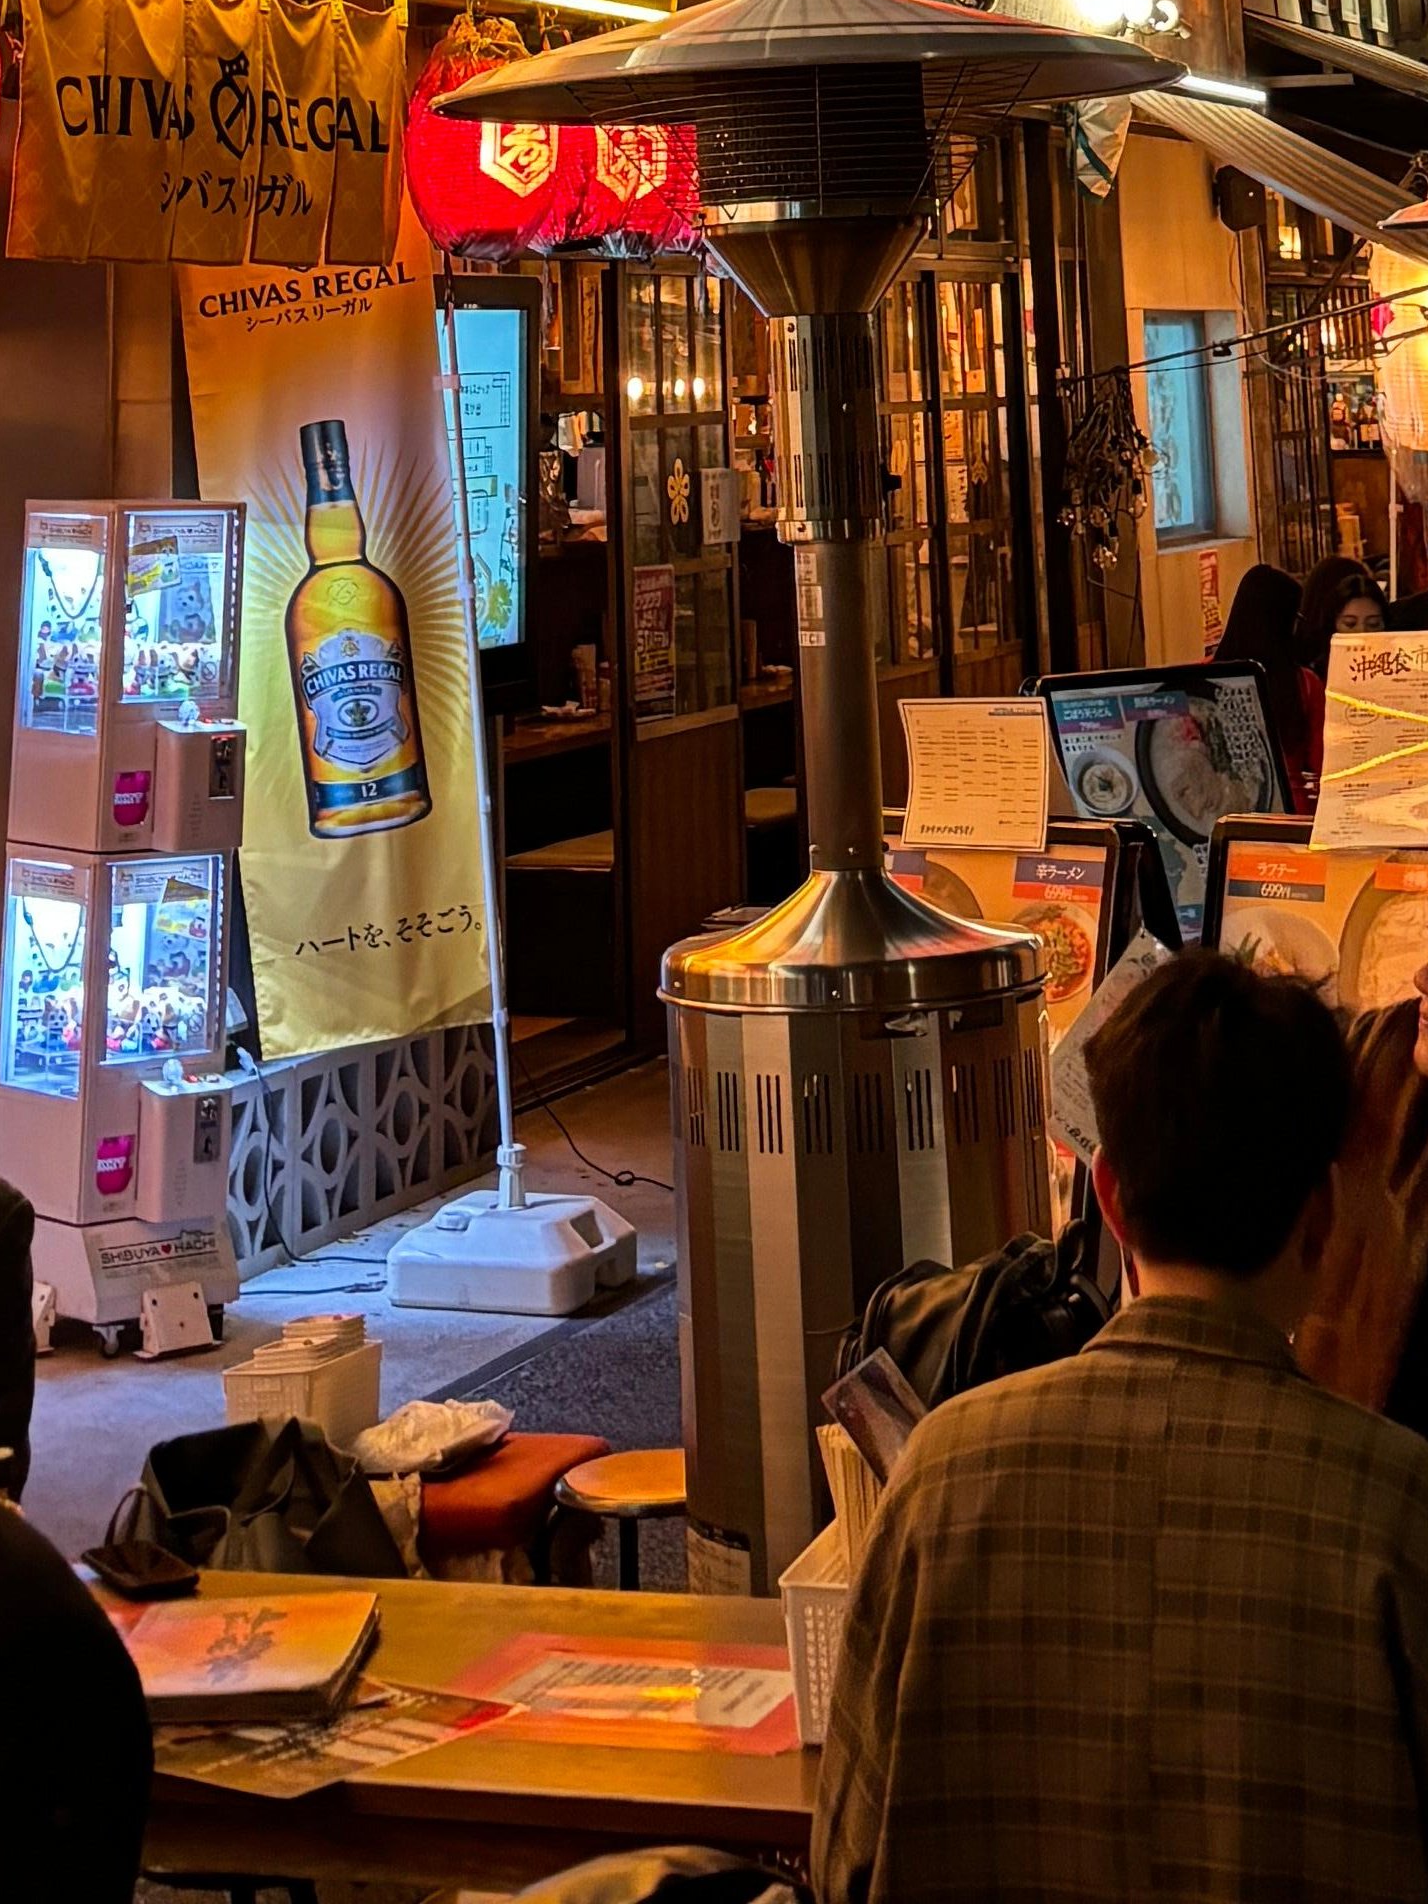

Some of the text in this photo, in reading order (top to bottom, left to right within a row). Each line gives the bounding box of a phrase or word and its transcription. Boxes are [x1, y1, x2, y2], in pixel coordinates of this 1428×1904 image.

[56, 75, 391, 155] CHIVAS REGAL
[198, 261, 416, 317] CHIVAS REGAL
[244, 297, 373, 334] シーバスリーガル
[306, 662, 402, 695] CHIVAS REGAL
[361, 782, 378, 798] 12
[294, 902, 483, 958] ハートを、そそごう。
